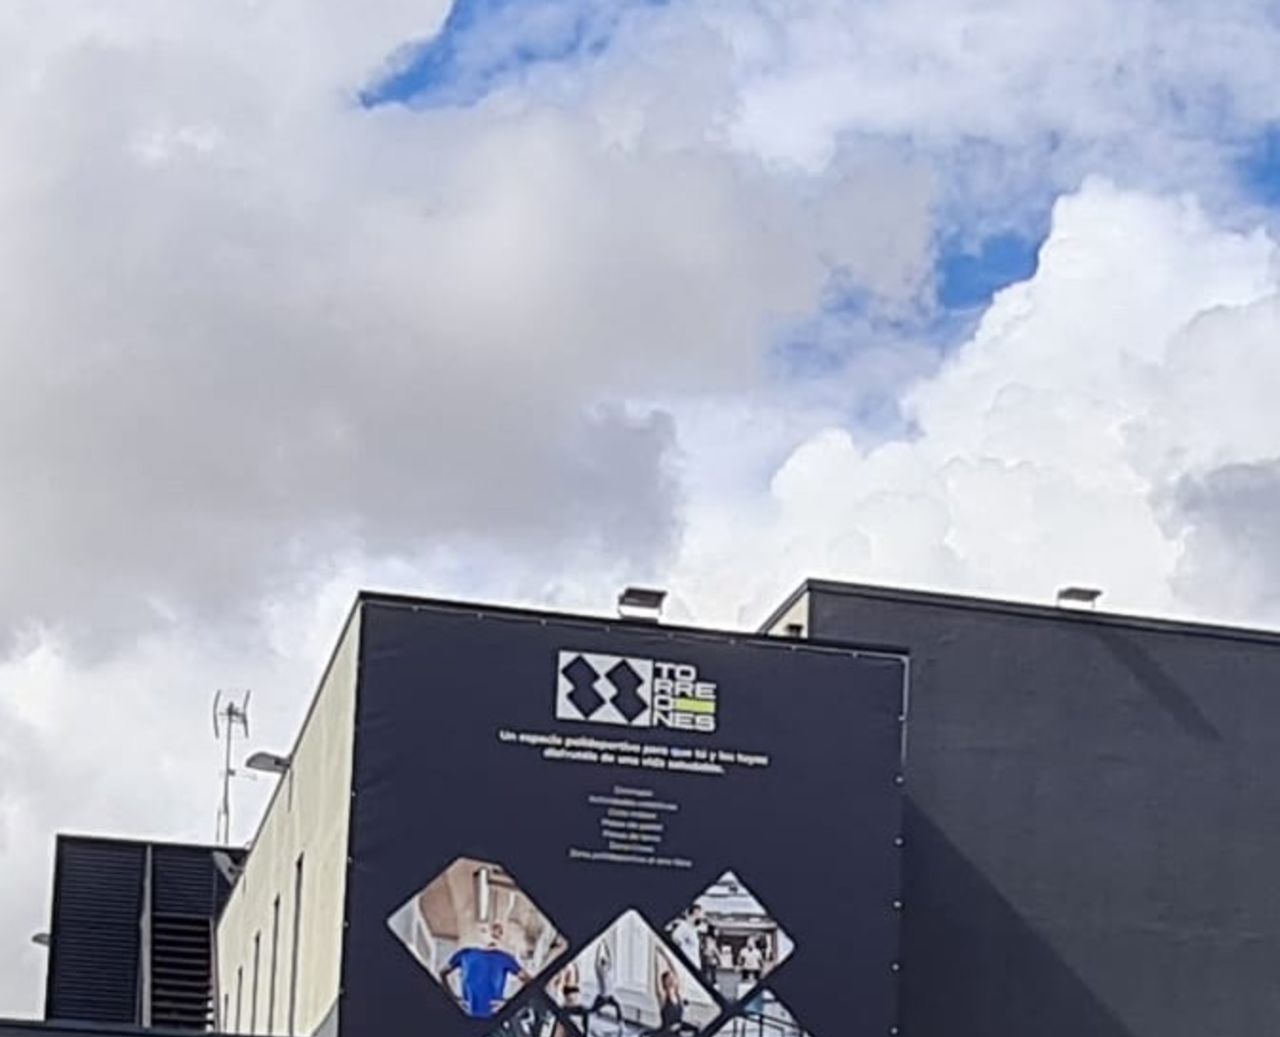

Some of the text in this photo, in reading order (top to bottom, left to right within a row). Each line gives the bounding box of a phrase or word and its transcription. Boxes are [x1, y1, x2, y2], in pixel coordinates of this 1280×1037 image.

[655, 662, 696, 681] TO
[654, 678, 717, 700] RRE
[652, 710, 716, 732] NES
[499, 730, 517, 741] Un
[519, 733, 562, 747] espacio
[564, 736, 640, 753] polideportivo
